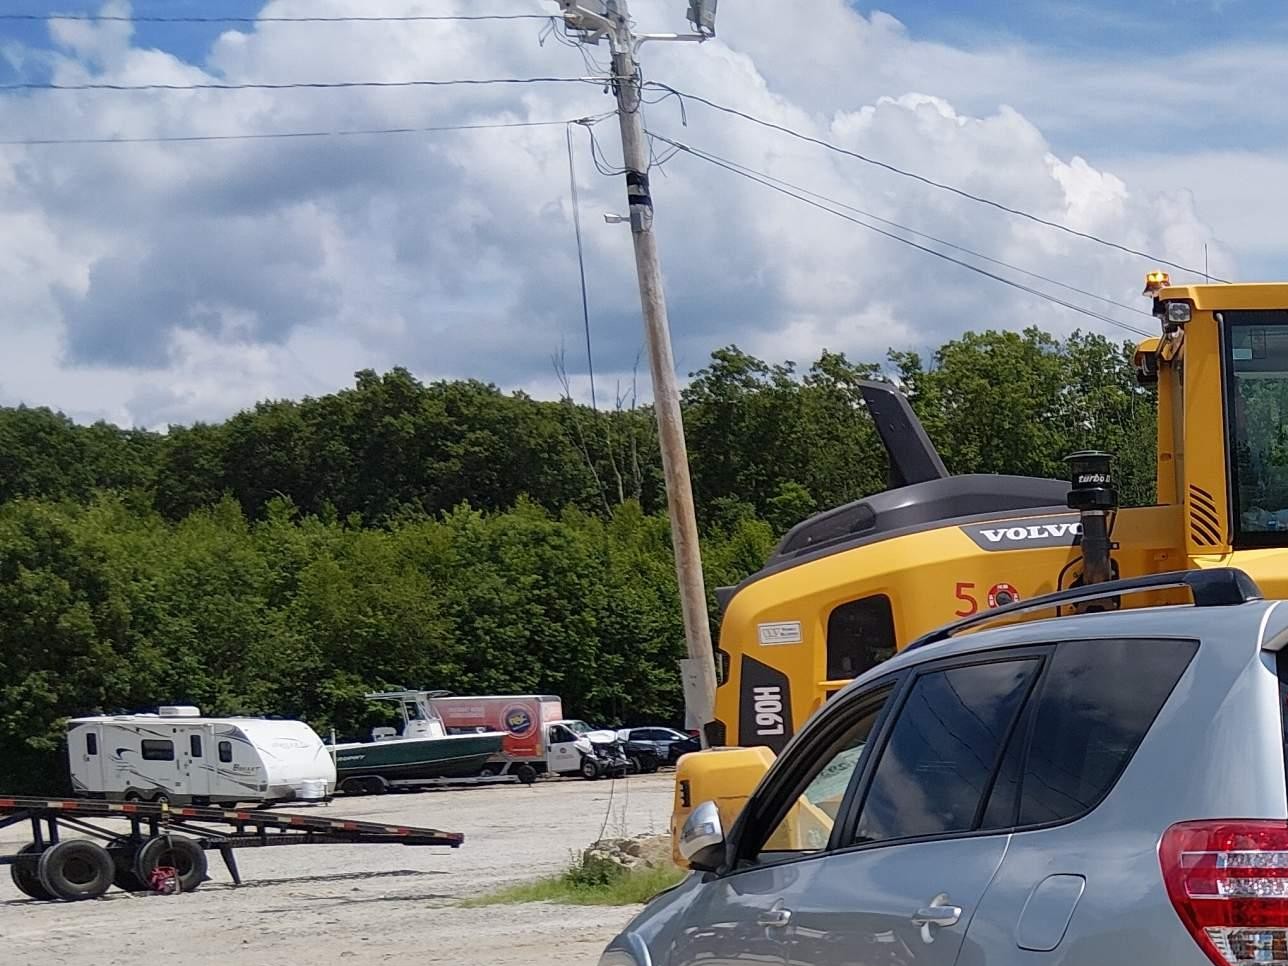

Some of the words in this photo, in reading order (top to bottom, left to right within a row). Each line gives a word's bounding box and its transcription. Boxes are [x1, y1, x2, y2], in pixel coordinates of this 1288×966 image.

[1079, 474, 1104, 483] turbo
[980, 522, 1084, 542] VOLVO
[753, 686, 785, 736] L90H
